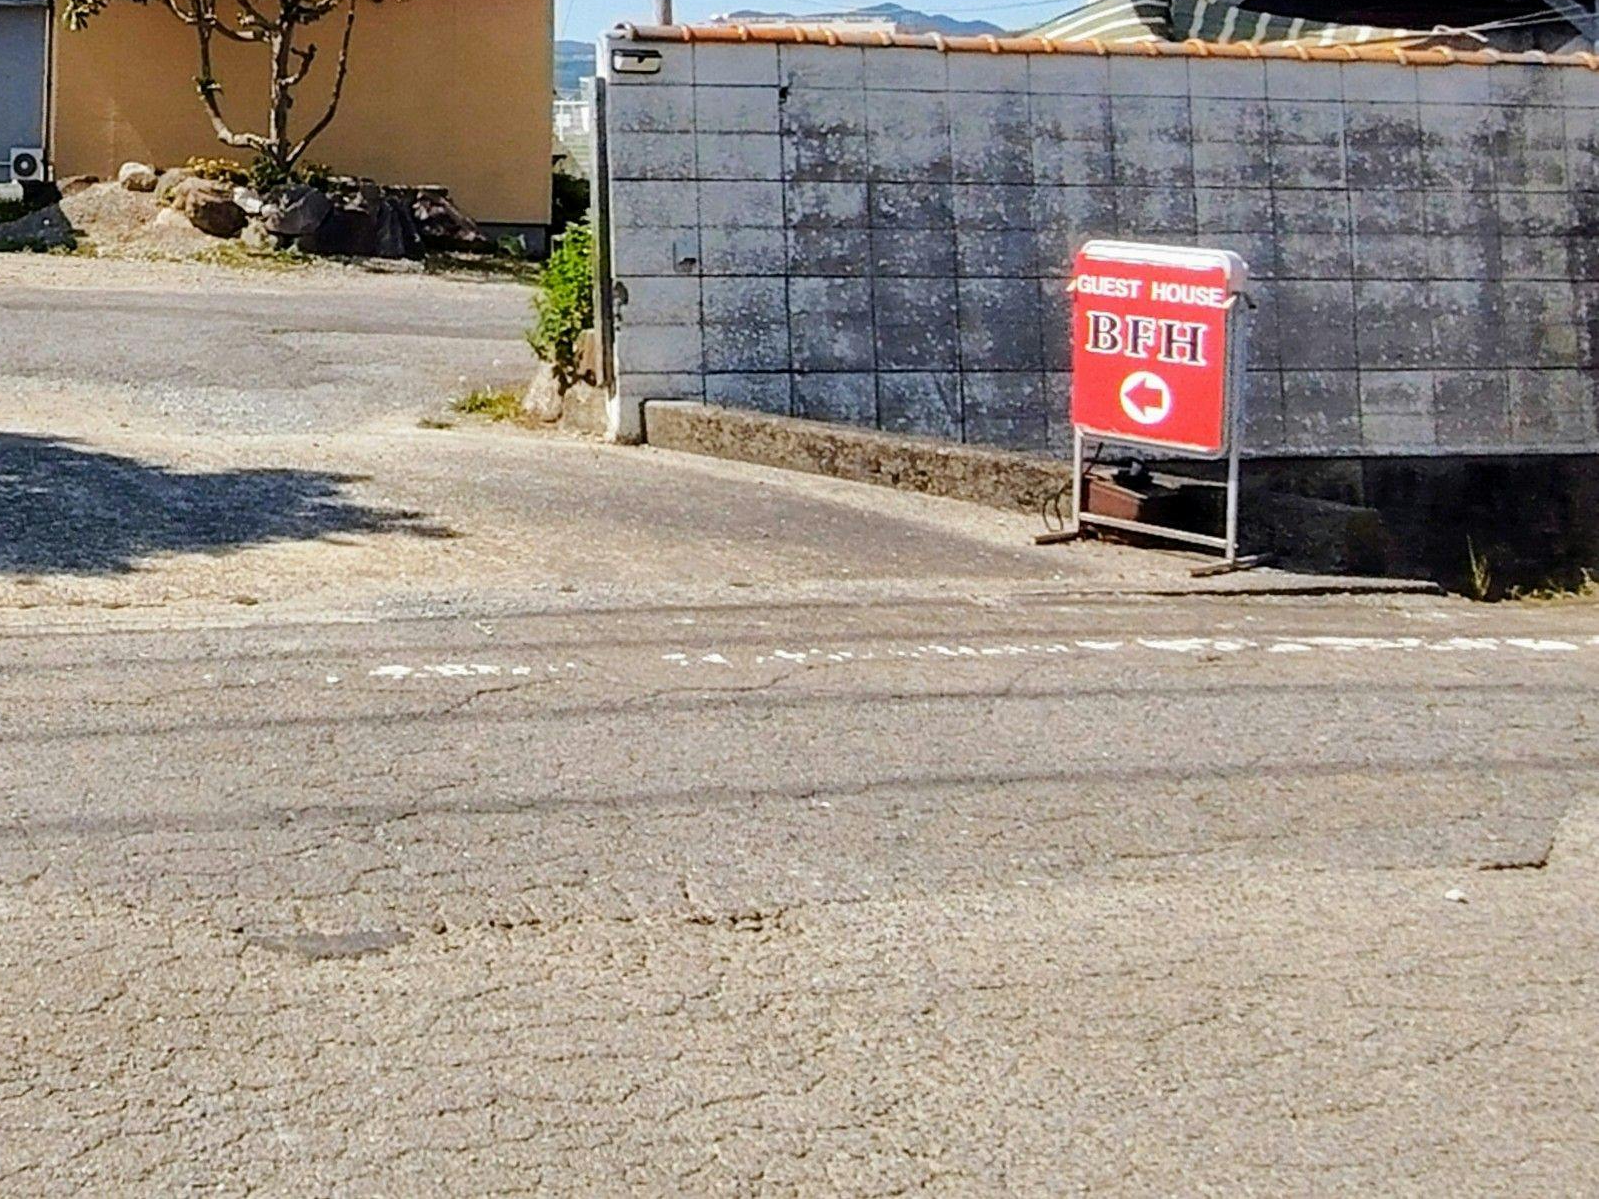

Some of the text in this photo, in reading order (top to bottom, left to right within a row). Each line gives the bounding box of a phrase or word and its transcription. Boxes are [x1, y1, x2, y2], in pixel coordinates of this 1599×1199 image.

[1077, 274, 1225, 307] GUEST HOUSE
[1085, 310, 1207, 366] BFH
